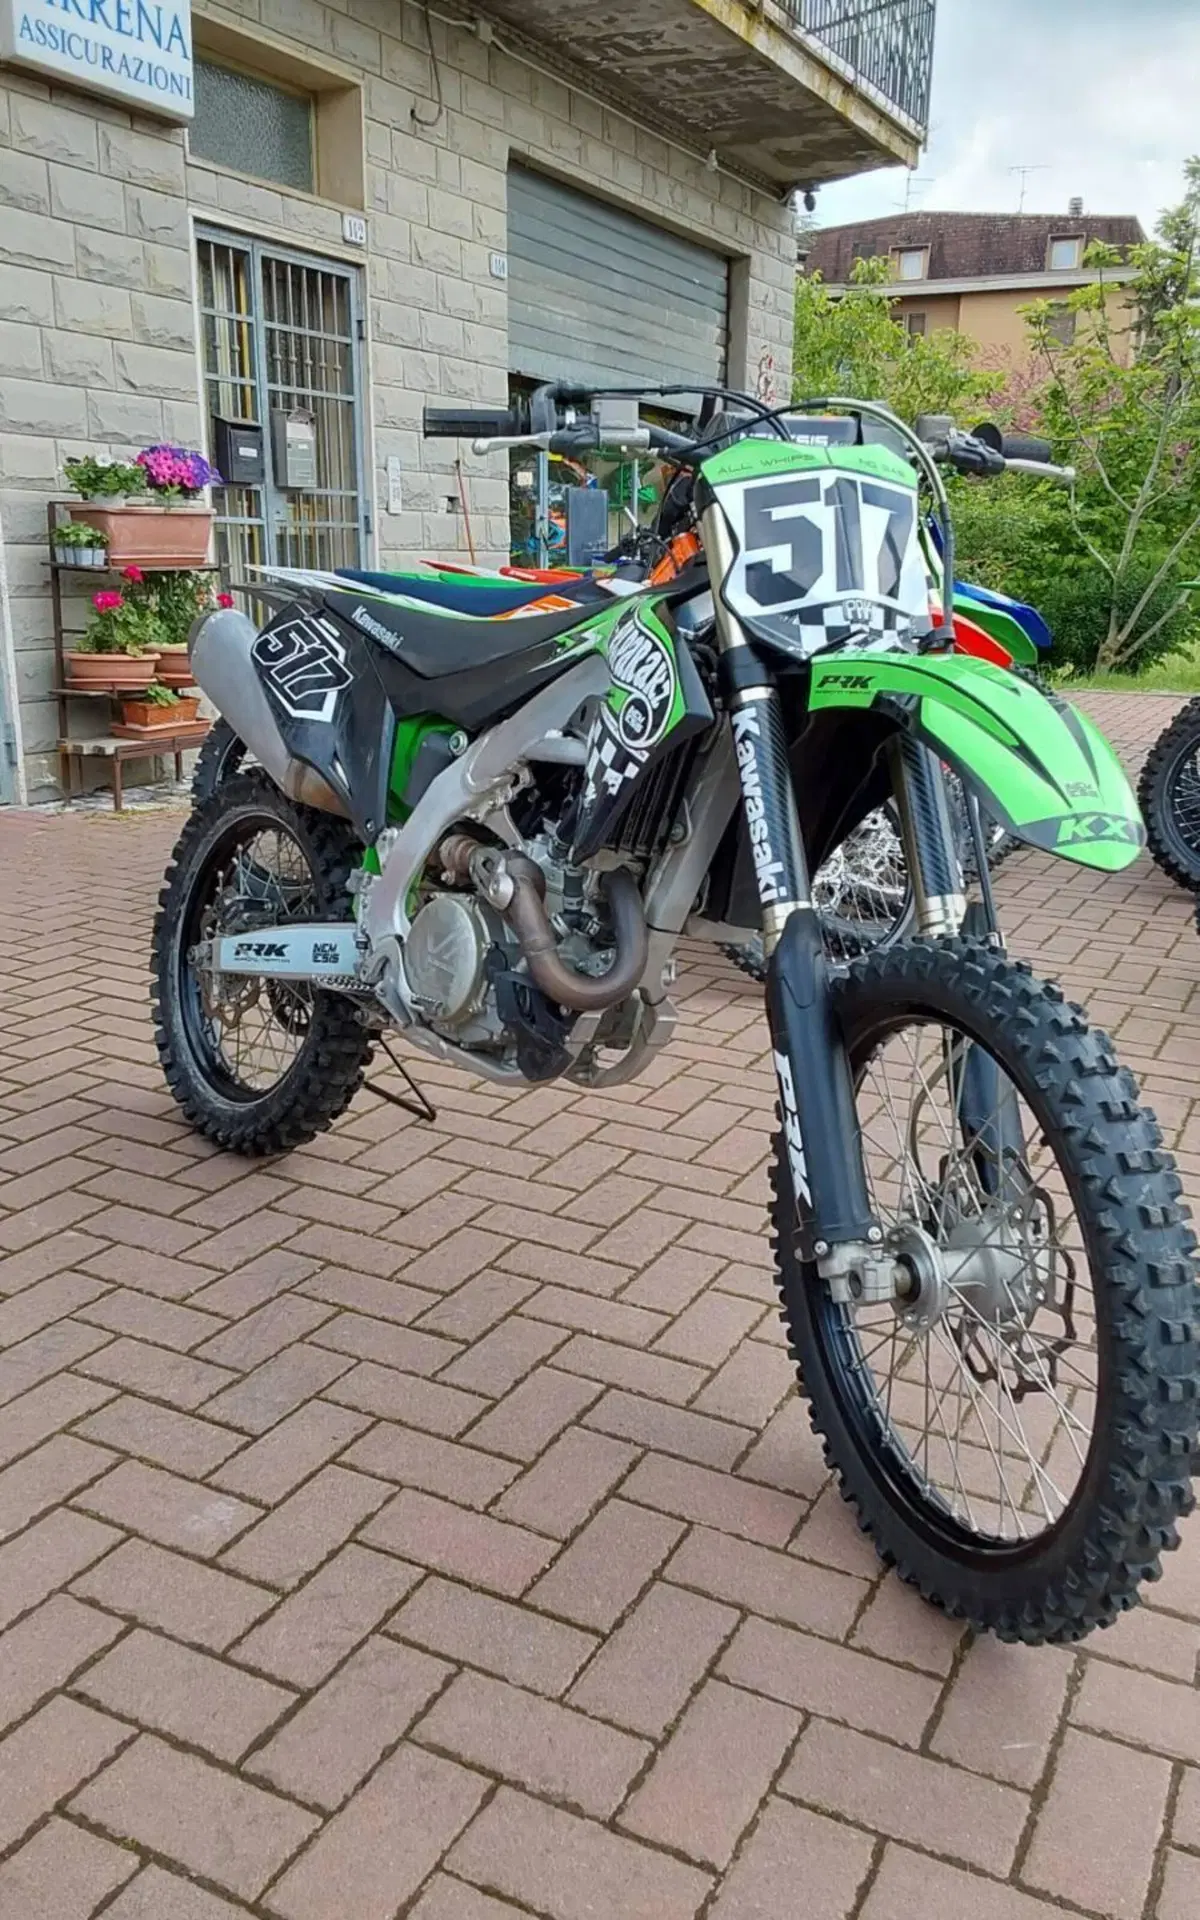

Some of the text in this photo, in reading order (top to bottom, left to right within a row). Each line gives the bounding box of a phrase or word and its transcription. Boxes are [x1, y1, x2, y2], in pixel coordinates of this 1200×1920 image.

[19, 13, 192, 100] ASSICURAZIONI
[743, 476, 914, 608] 517
[252, 619, 355, 701] 517
[351, 605, 404, 650] Kawasaki
[816, 675, 878, 689] PRK
[732, 706, 788, 904] Kawasaki
[1057, 815, 1131, 843] KX
[234, 943, 291, 957] PRK
[773, 1049, 813, 1210] PRK
